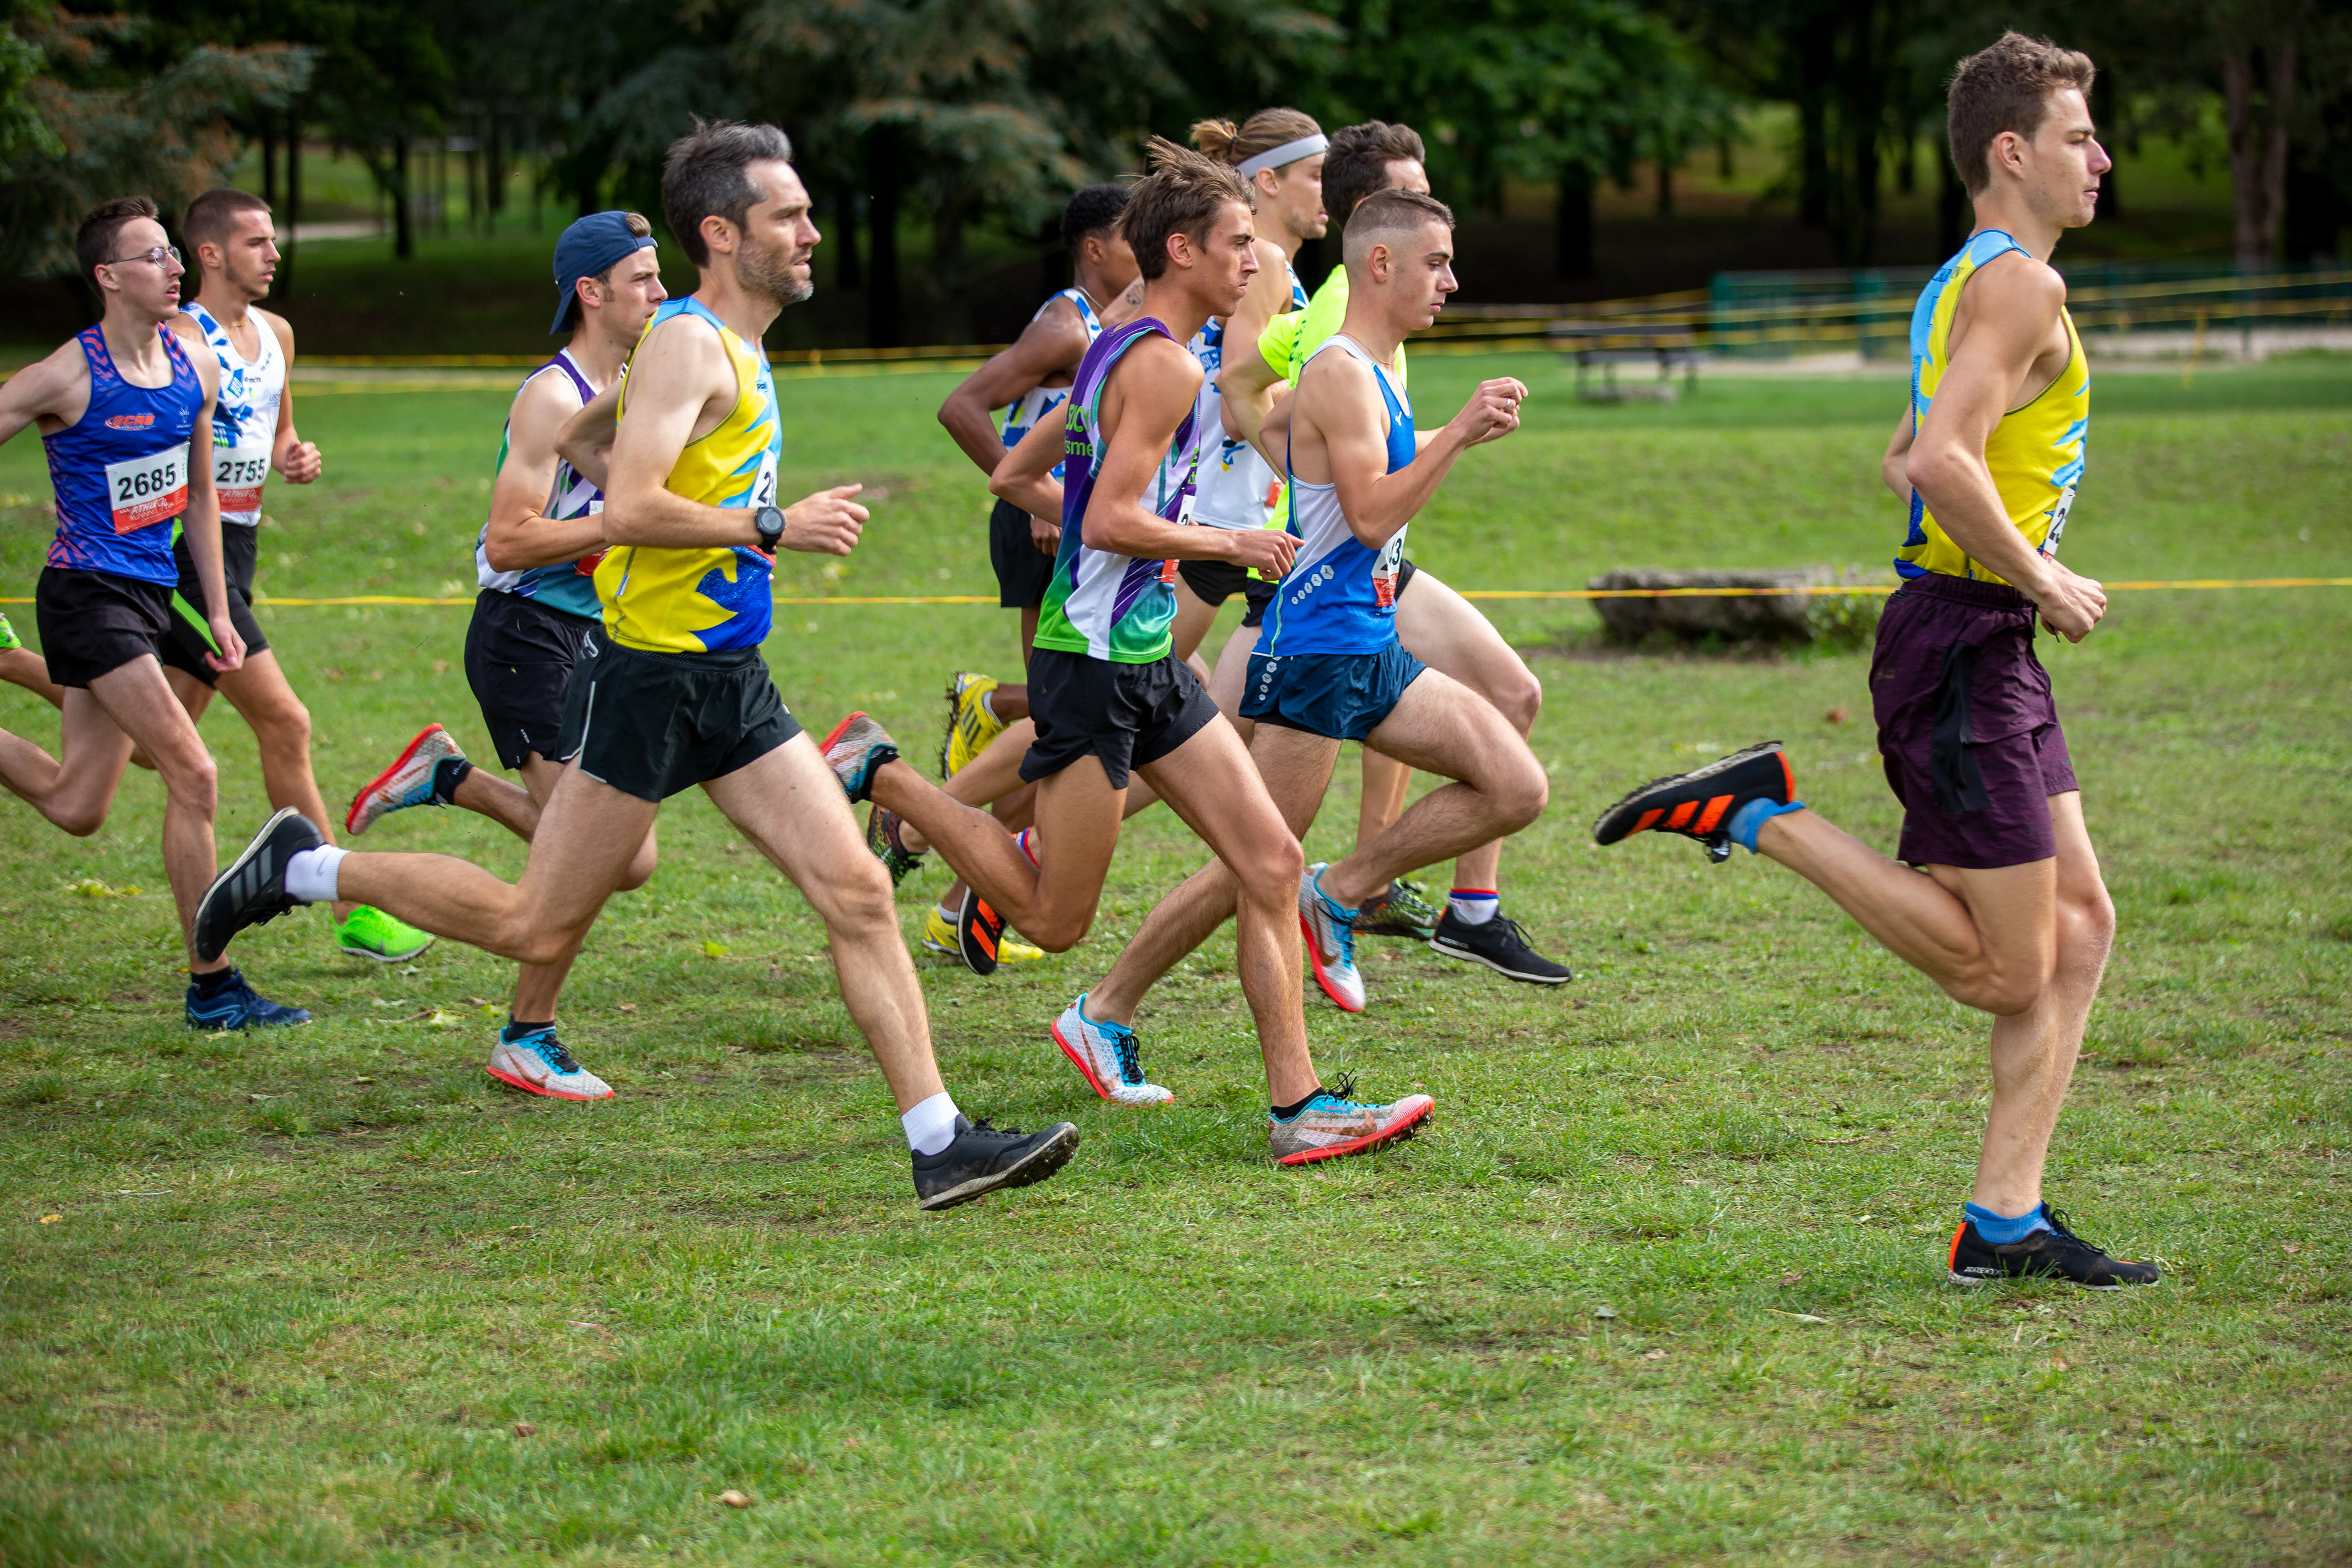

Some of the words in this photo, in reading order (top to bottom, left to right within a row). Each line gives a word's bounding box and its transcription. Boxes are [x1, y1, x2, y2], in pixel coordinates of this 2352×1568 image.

[113, 415, 155, 425] SCAB
[118, 462, 177, 502] 2685
[216, 459, 266, 483] 2755
